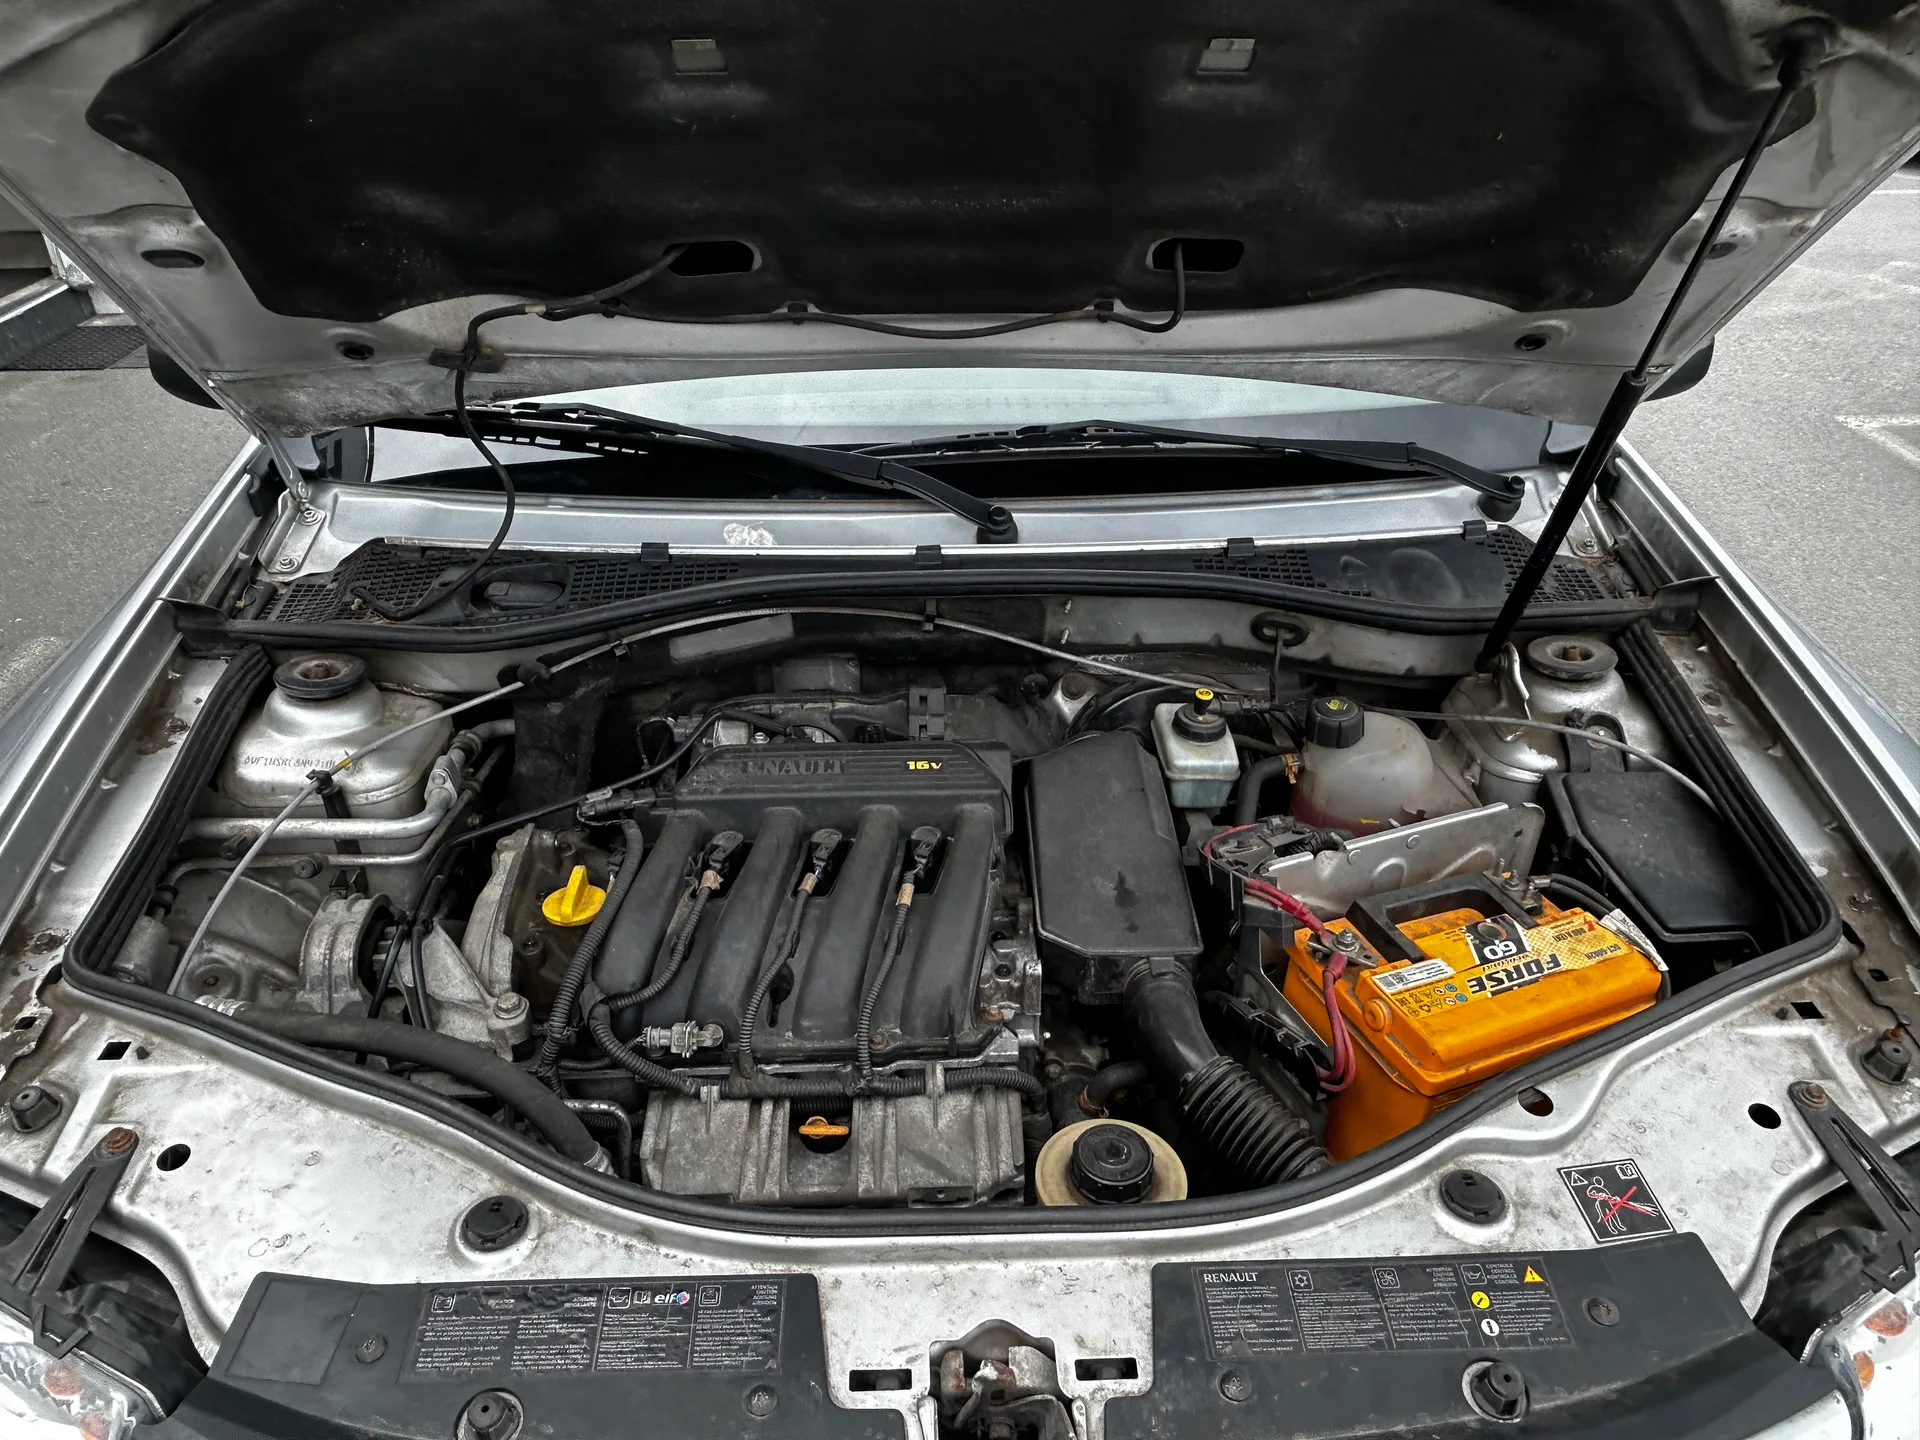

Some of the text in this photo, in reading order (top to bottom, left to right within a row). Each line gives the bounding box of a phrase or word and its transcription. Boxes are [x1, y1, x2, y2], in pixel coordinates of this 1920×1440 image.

[1483, 941, 1517, 960] 60
[1466, 953, 1562, 995] FORSE
[1203, 1272, 1258, 1283] RENAULT
[653, 1293, 677, 1304] elf
